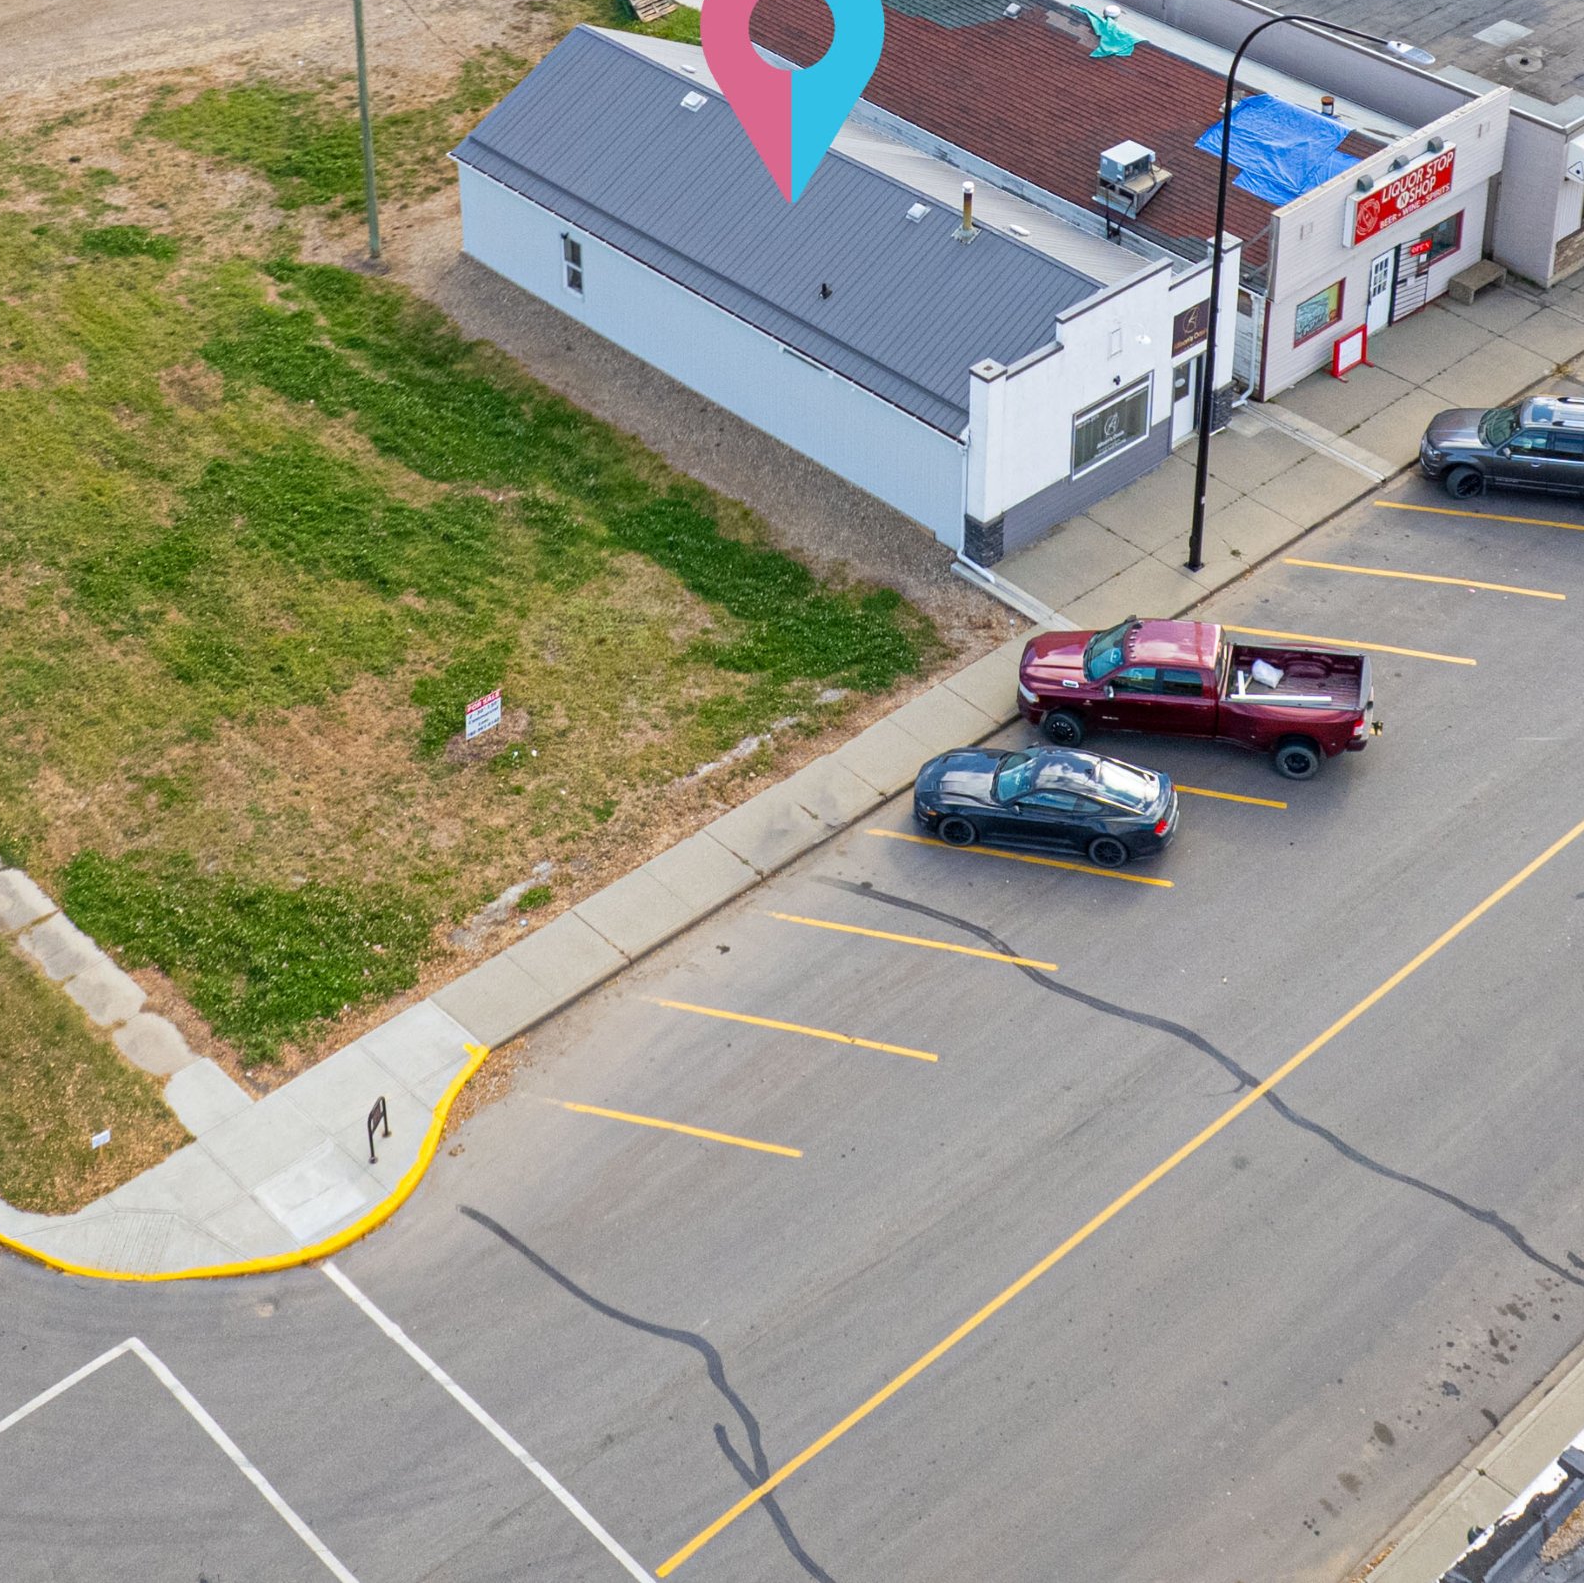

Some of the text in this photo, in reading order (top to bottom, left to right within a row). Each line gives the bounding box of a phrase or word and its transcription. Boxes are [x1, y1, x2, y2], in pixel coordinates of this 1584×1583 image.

[1382, 151, 1454, 204] LIQUOR STOP
[1408, 175, 1437, 200] SHOP
[1379, 212, 1397, 229] BEER
[1402, 200, 1421, 216] WINE
[1425, 183, 1450, 203] SPIRITS
[1410, 241, 1430, 254] OPEN
[467, 700, 482, 714] FOR
[481, 689, 501, 706] SALE
